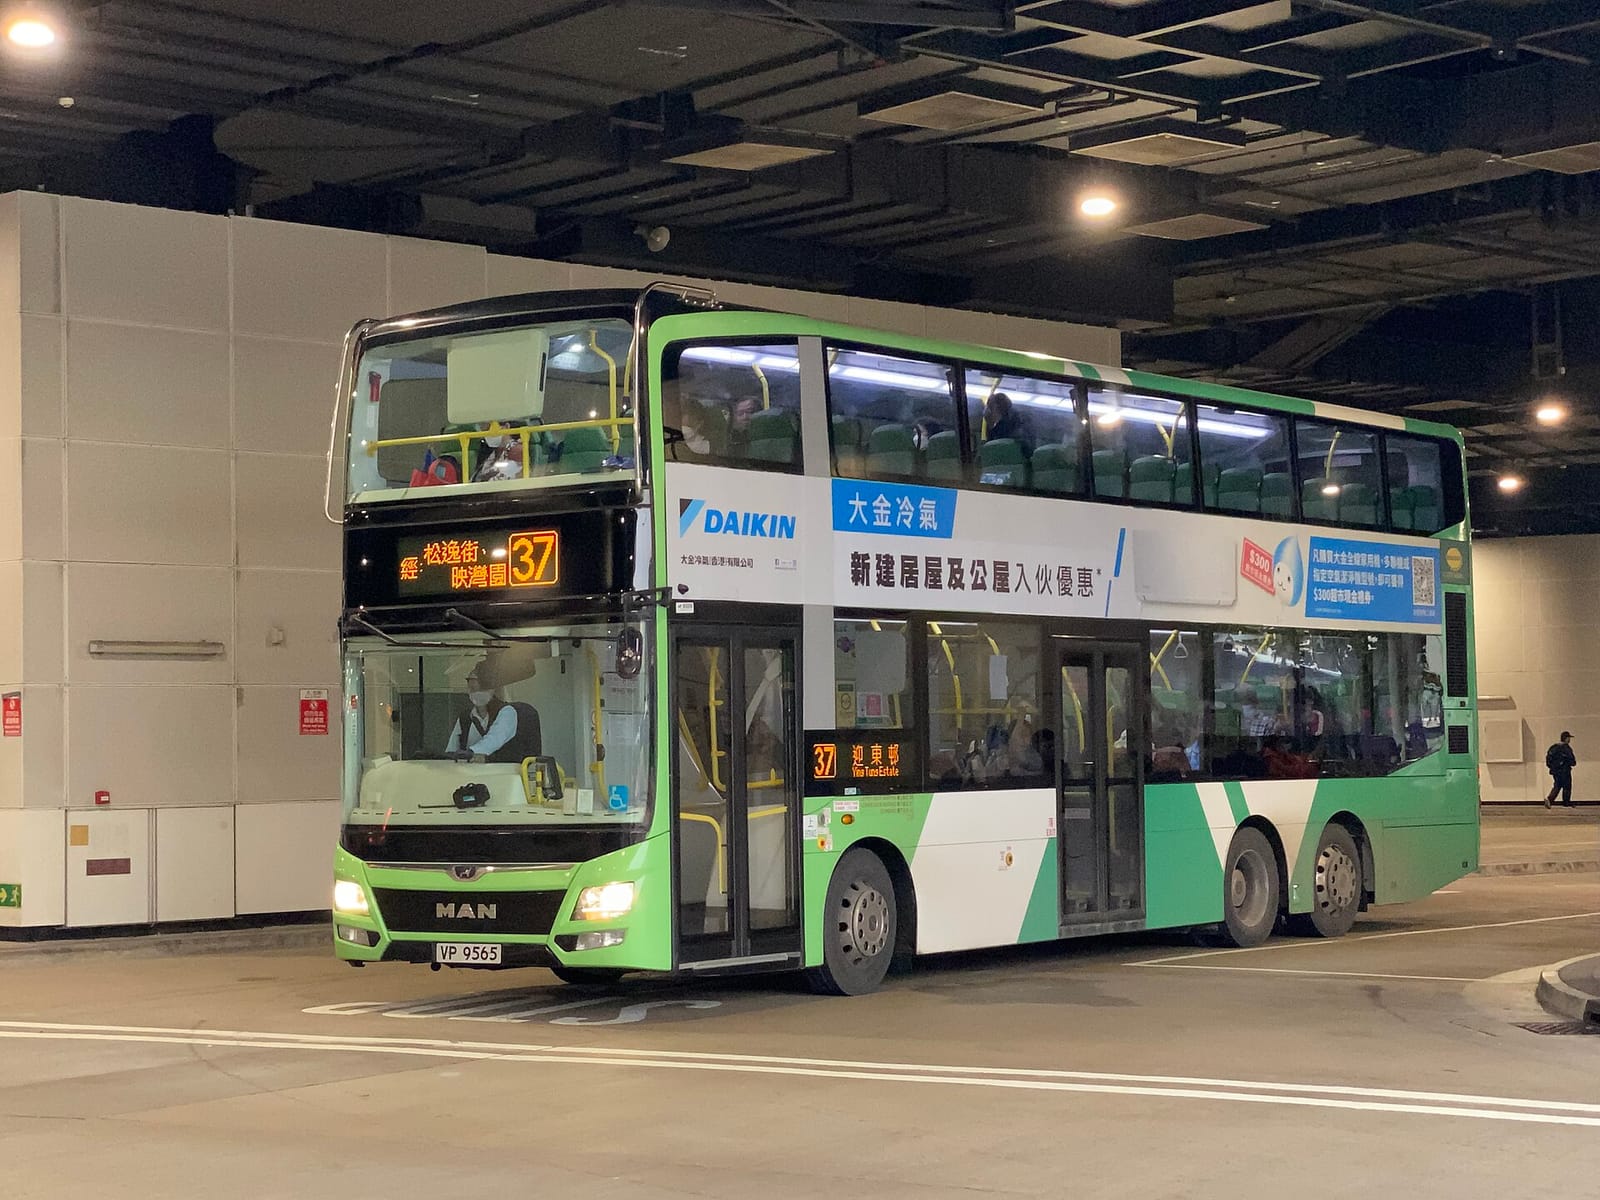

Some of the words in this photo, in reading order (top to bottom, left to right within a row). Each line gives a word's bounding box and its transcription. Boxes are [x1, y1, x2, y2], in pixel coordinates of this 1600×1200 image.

[704, 509, 796, 539] DAIKIN
[848, 490, 938, 531] 大金冷氣
[512, 536, 556, 582] 37
[451, 563, 507, 589] 映灣園
[814, 746, 834, 776] 37
[879, 766, 900, 777] Estate
[436, 903, 497, 919] MAN
[440, 946, 457, 960] VP
[463, 946, 498, 961] 9565
